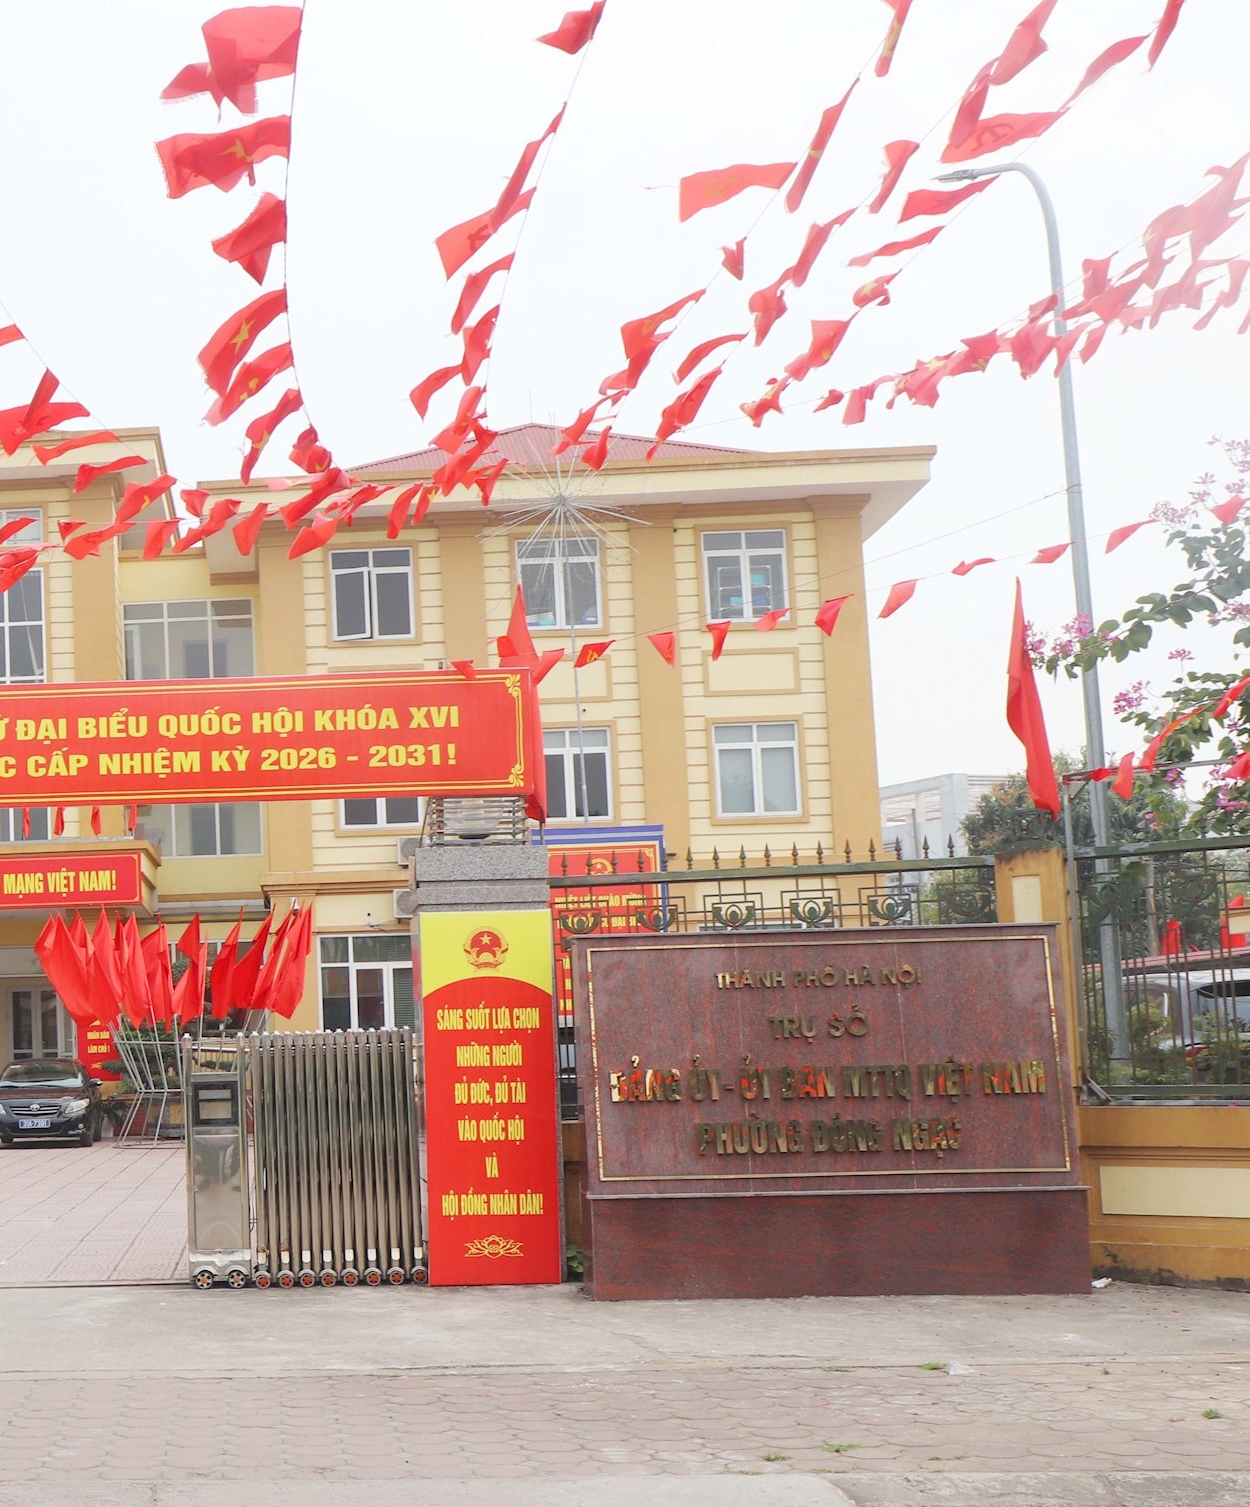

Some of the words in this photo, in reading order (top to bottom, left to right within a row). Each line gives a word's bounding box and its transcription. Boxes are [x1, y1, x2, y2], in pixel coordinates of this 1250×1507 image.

[15, 715, 68, 749] ĐẠI
[78, 708, 147, 738] BIỂU
[159, 706, 241, 738] QUỐC
[252, 707, 303, 737] HỘI
[315, 704, 399, 731] KHÓA
[409, 706, 458, 728] XVI
[28, 743, 88, 777] CẤP
[99, 748, 200, 778] NHIỆM
[212, 746, 250, 771] KỲ
[261, 747, 336, 770] 2026
[369, 744, 455, 766] 2031!
[4, 873, 43, 898] MẠNG
[47, 868, 75, 897] VIỆT
[79, 870, 116, 891] NAM!
[715, 969, 786, 989] THÀNH
[845, 965, 875, 986] HÀ
[882, 963, 922, 988] NỘI
[437, 1005, 463, 1030] SÁNG
[466, 1002, 490, 1030] SUỐT
[492, 1006, 511, 1033] LỰA
[513, 1008, 539, 1033] CHỌN
[769, 1016, 818, 1043] TRỤ
[829, 1004, 869, 1037] SỞ
[457, 1042, 490, 1066] NHỮNG
[492, 1040, 522, 1066] NGƯỜI
[455, 1076, 468, 1104] ĐỦ
[470, 1079, 493, 1105] ĐỨC,
[495, 1075, 508, 1103] ĐỦ
[510, 1078, 525, 1103] TÀI
[609, 1055, 681, 1102] ĐẢNG
[739, 1054, 771, 1099] ỦY
[781, 1065, 836, 1098] BAN
[843, 1064, 911, 1101] MTTQ
[918, 1056, 972, 1104] VIỆT
[981, 1061, 1046, 1094] NAM
[458, 1116, 478, 1141] VÀO
[480, 1112, 505, 1143] QUỐC
[508, 1115, 524, 1144] HỘI
[813, 1113, 882, 1152] ĐÔNG
[892, 1114, 962, 1158] NGẠC
[486, 1153, 498, 1177] VÀ
[442, 1190, 459, 1220] HỘI
[461, 1187, 487, 1215] ĐỒNG
[490, 1190, 517, 1215] NHÂN
[520, 1189, 543, 1214] DÂN!
